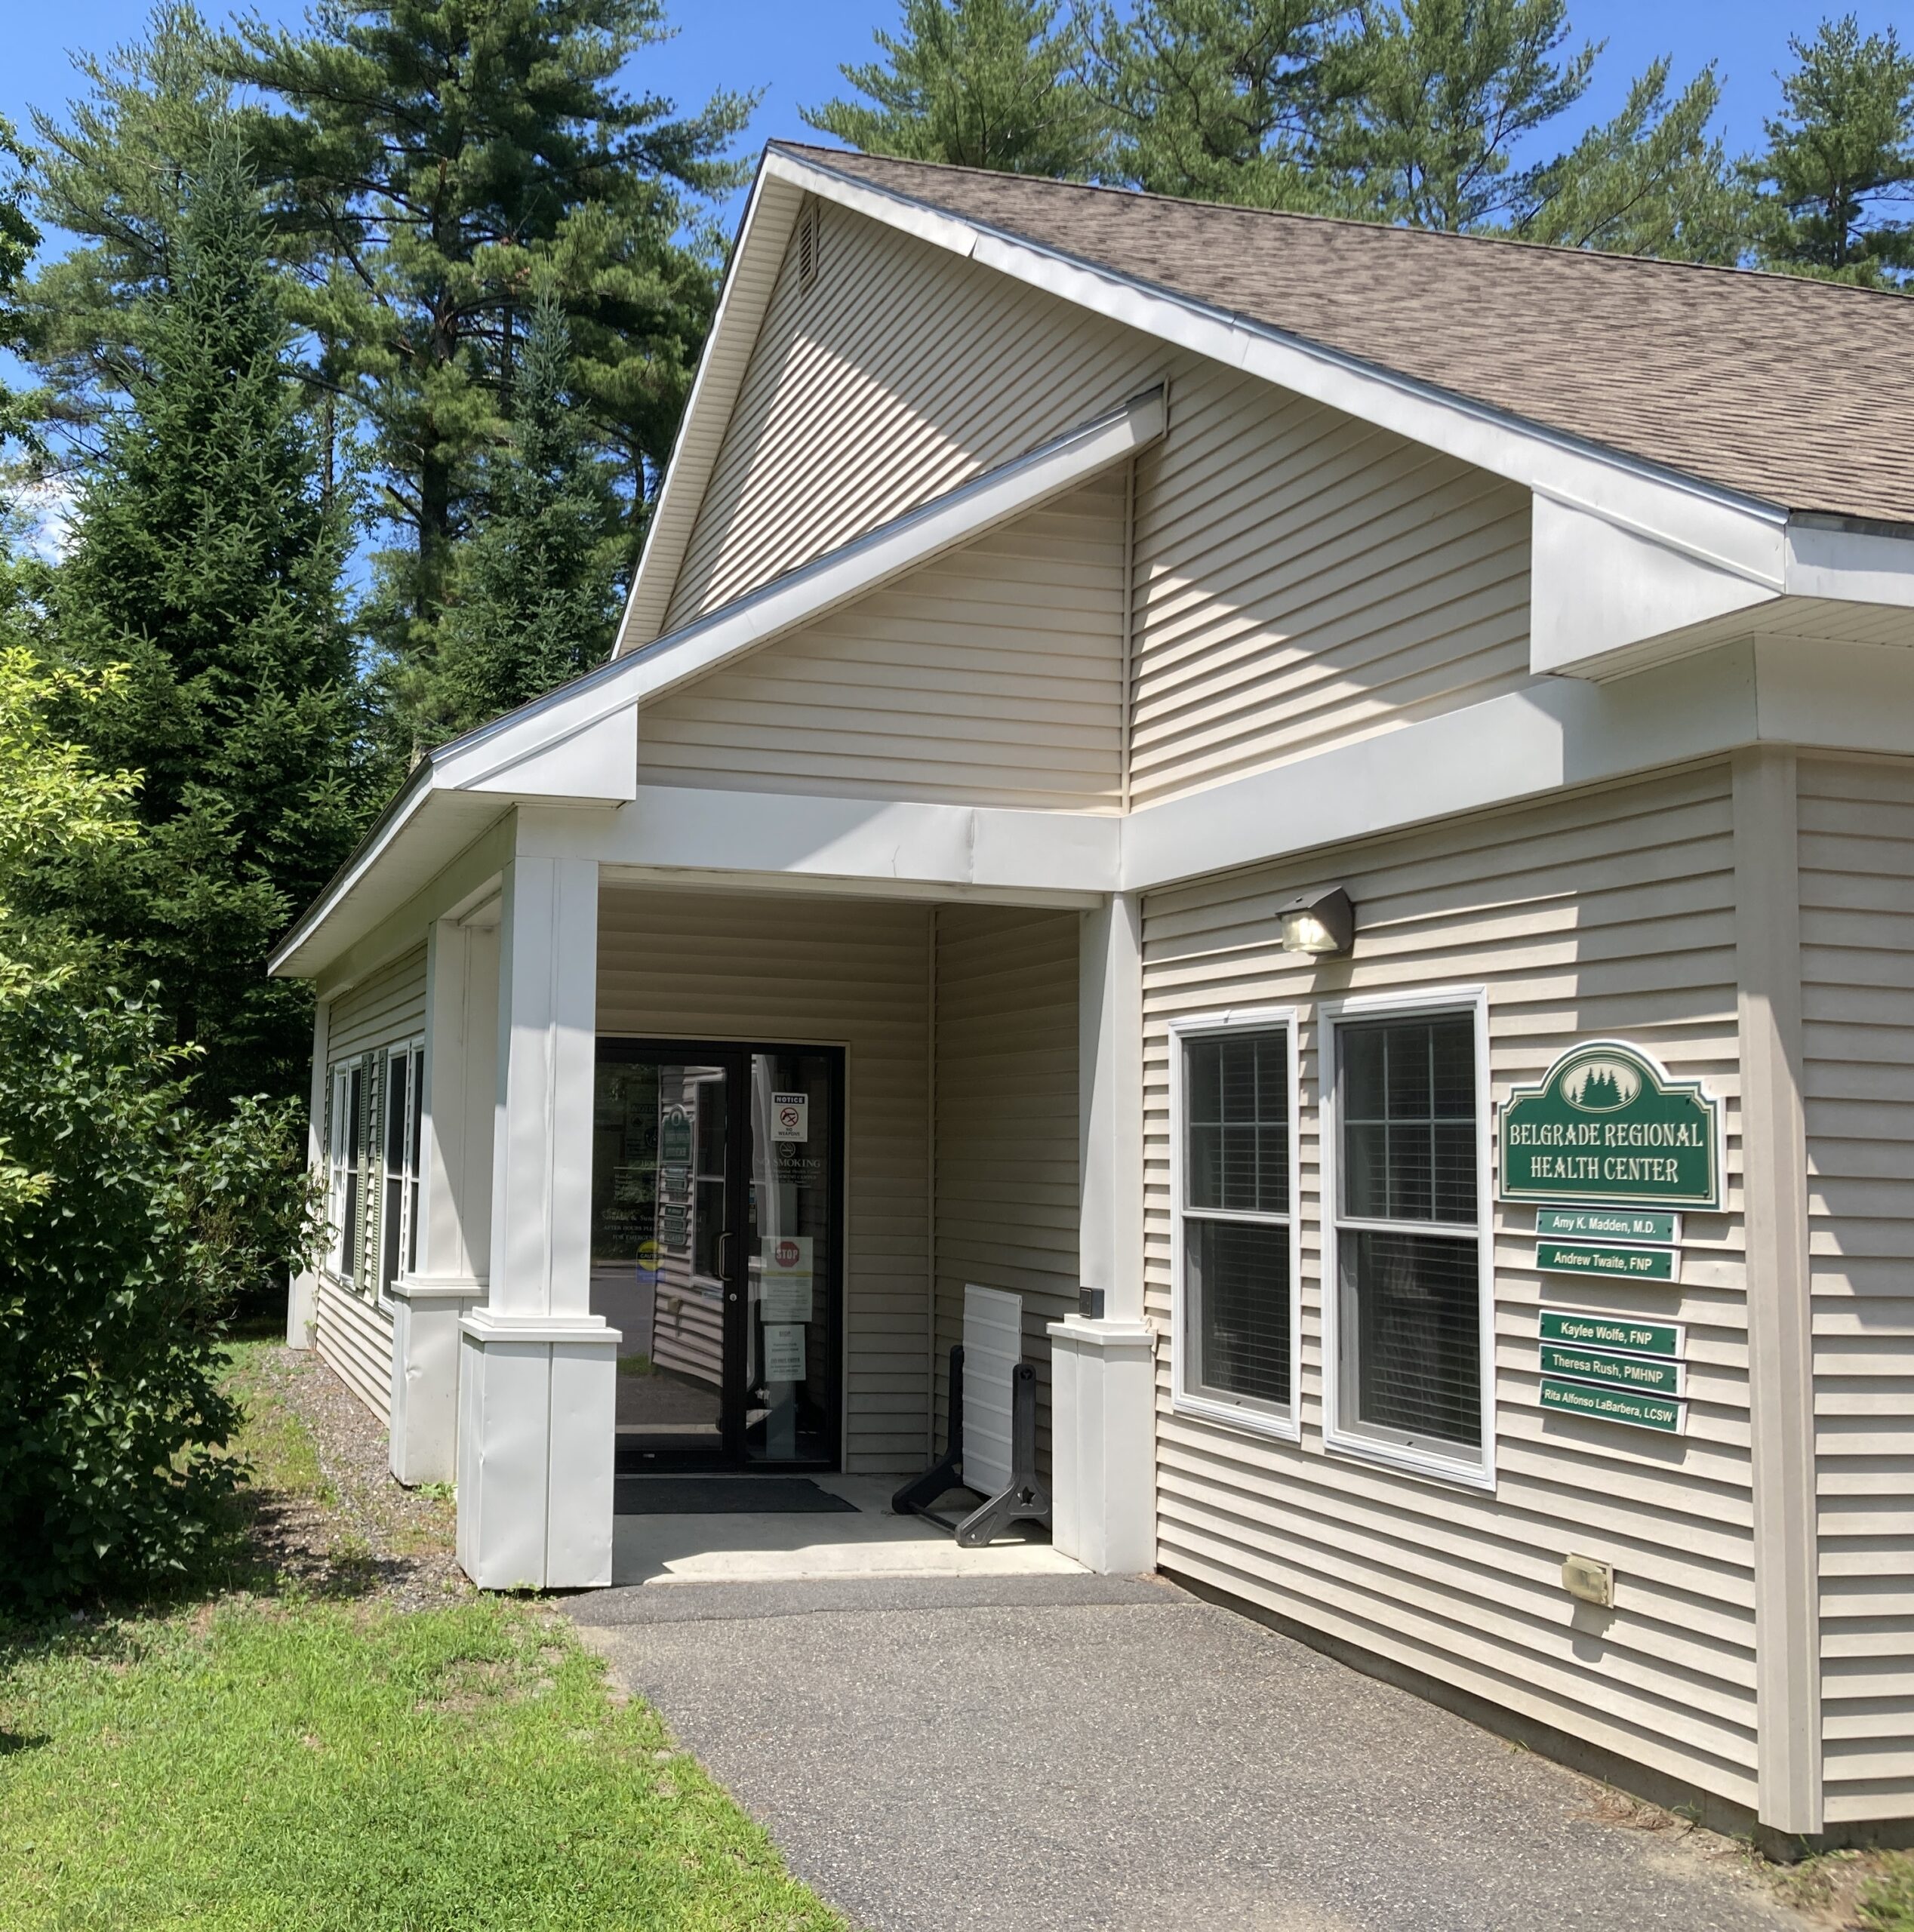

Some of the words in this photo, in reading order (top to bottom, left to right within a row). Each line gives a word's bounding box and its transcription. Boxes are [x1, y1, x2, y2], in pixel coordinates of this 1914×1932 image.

[1509, 1123, 1602, 1147] BELGRADE
[1604, 1123, 1703, 1148] REGIONAL
[773, 1158, 820, 1168] SMOKING
[1531, 1156, 1599, 1179] HEALTH
[1604, 1158, 1679, 1183] CENTER
[1552, 1216, 1574, 1231] Amy
[1577, 1217, 1586, 1229] K.
[1589, 1218, 1631, 1234] Madden,
[1633, 1220, 1656, 1234] M.D.
[776, 1249, 798, 1260] STOP
[1554, 1251, 1590, 1266] Andrew
[1593, 1254, 1627, 1270] Twaite,
[1629, 1258, 1652, 1271] FNP
[1561, 1322, 1593, 1339] Kaylee
[1596, 1327, 1627, 1343] Wolfe,
[1629, 1331, 1652, 1345] FNP
[1552, 1354, 1590, 1371] Theresa
[1593, 1361, 1622, 1378] Rush,
[1624, 1366, 1663, 1383] PMHNP
[1544, 1389, 1561, 1401] Rita
[1562, 1392, 1594, 1408] Alfonso
[1596, 1398, 1642, 1419] LaBarbera,
[1644, 1406, 1672, 1423] LCSW
